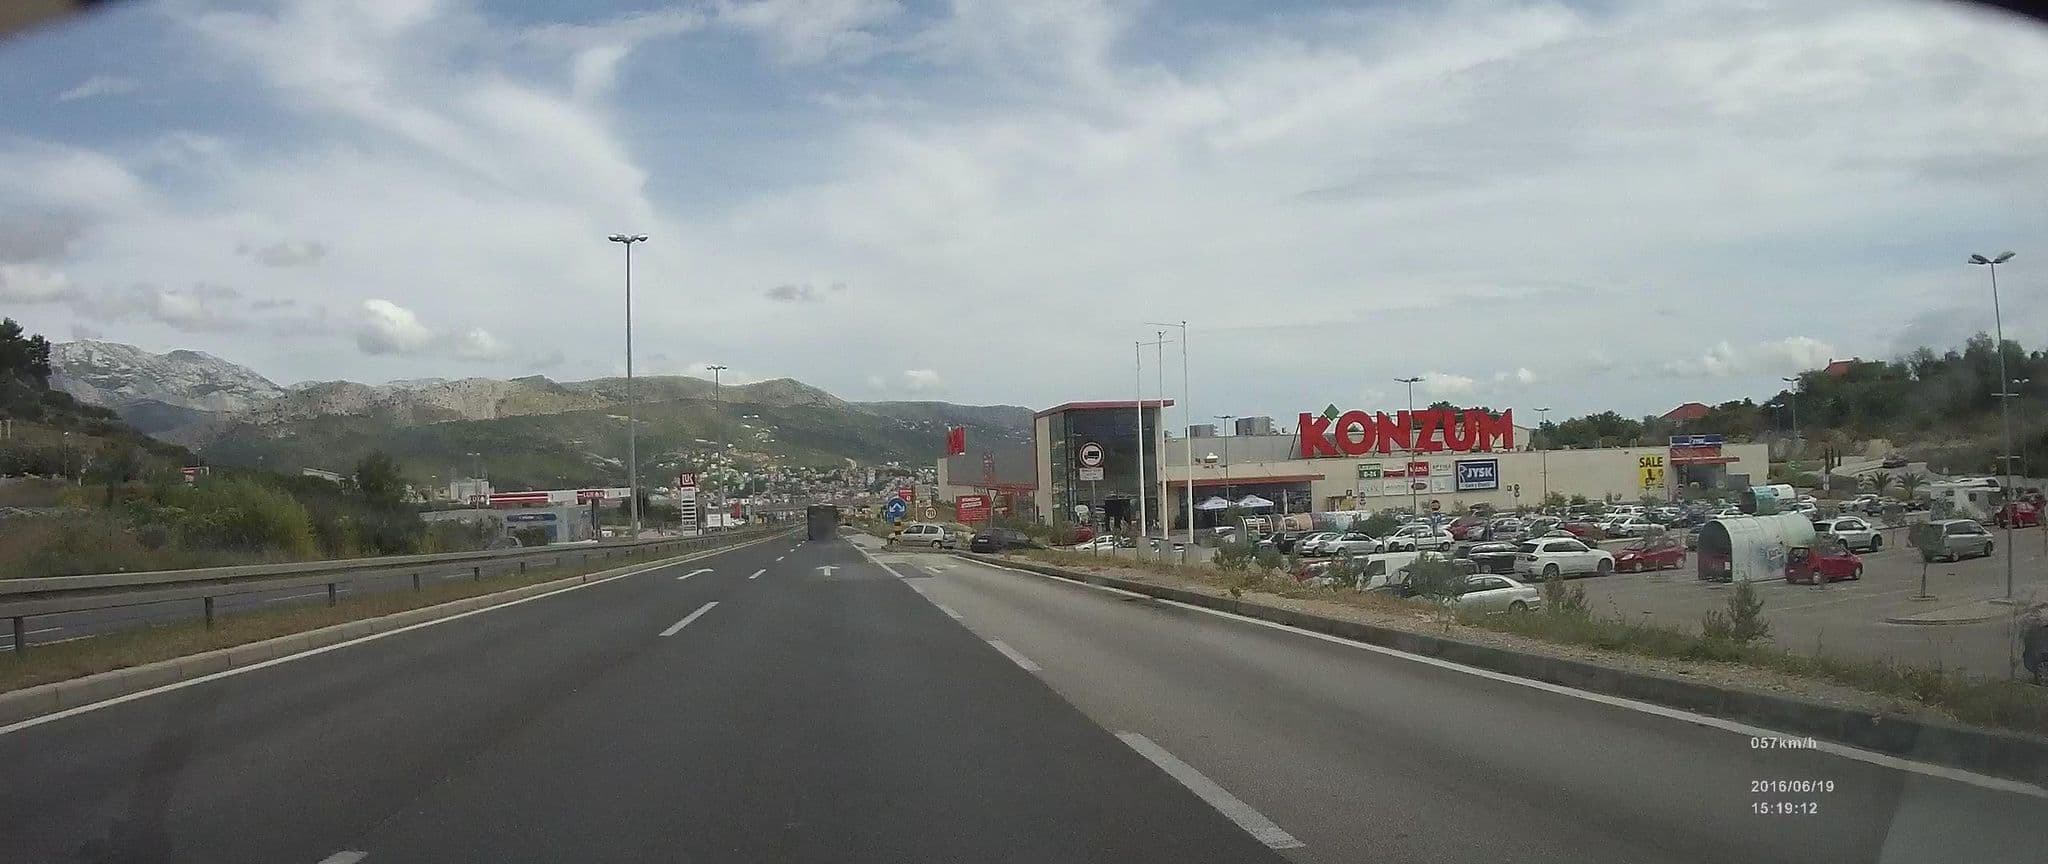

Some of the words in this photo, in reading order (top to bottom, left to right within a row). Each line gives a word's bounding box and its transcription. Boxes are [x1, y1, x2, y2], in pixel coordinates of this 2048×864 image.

[1299, 408, 1514, 458] KONZUM
[1639, 456, 1664, 468] SALE
[1466, 466, 1493, 478] JYSK
